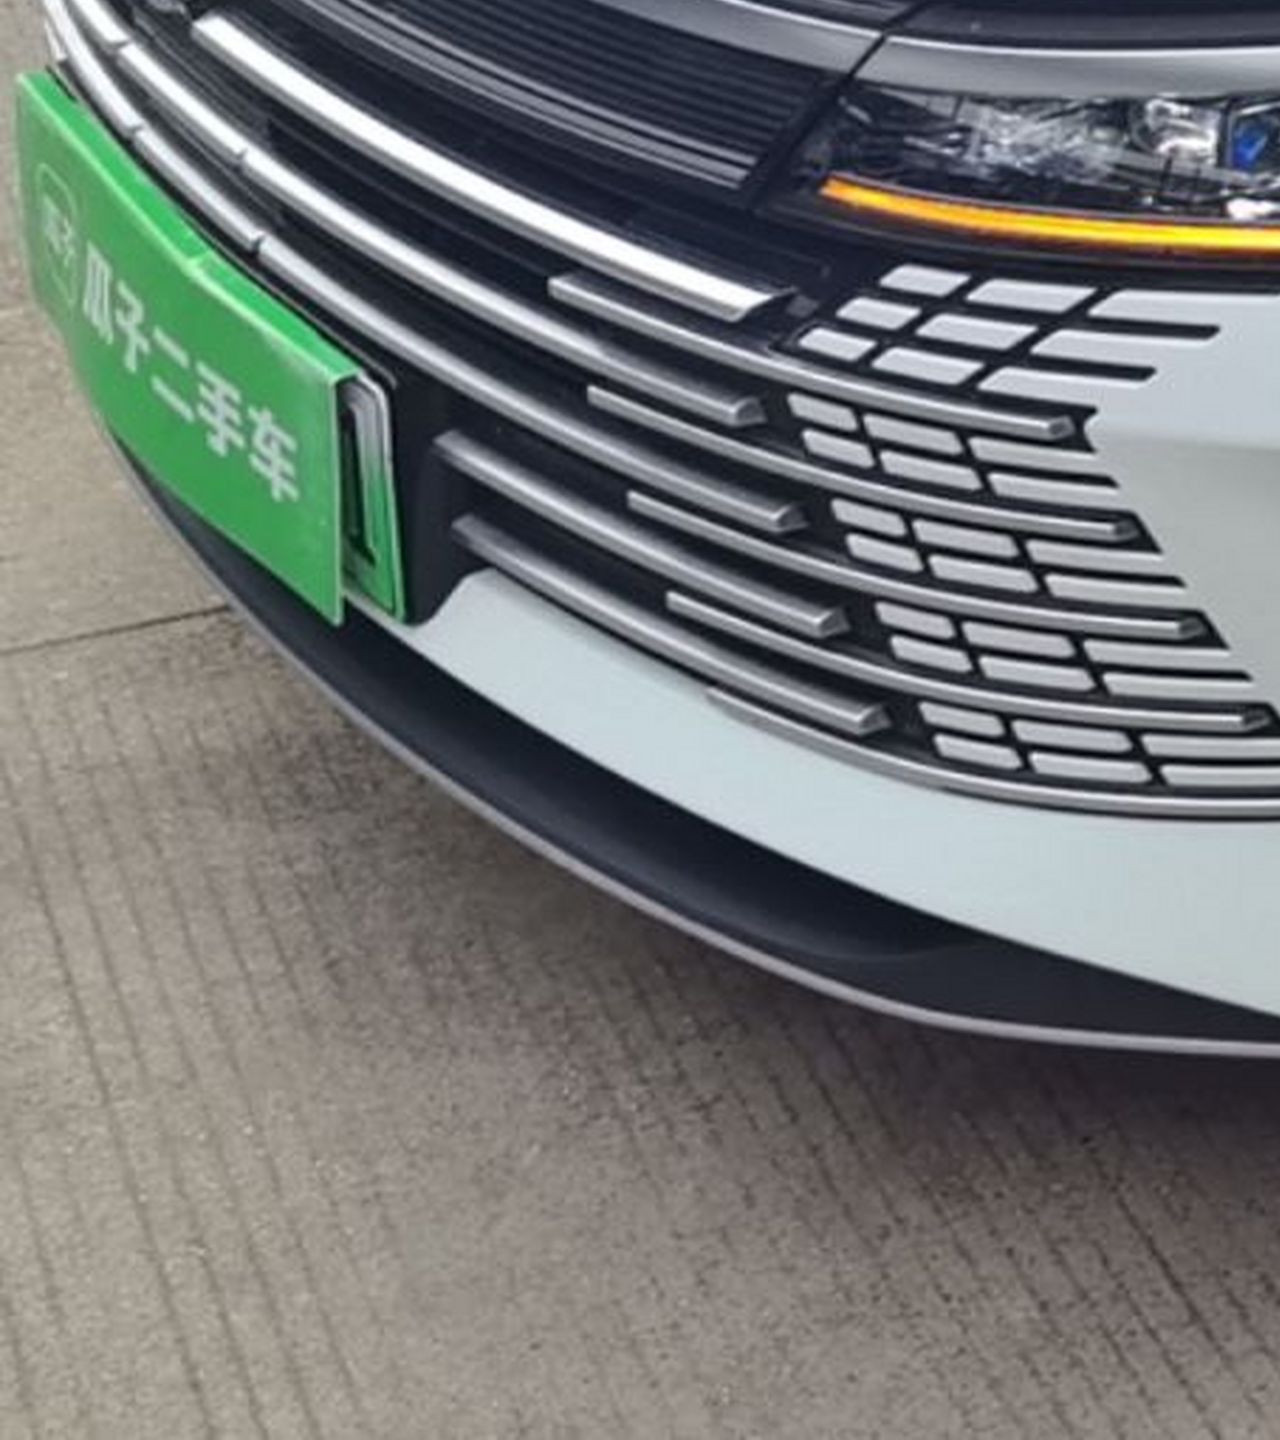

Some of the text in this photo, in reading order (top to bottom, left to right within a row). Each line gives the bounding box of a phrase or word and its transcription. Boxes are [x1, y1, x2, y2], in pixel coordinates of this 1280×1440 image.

[82, 240, 299, 503] 瓜子二手车
